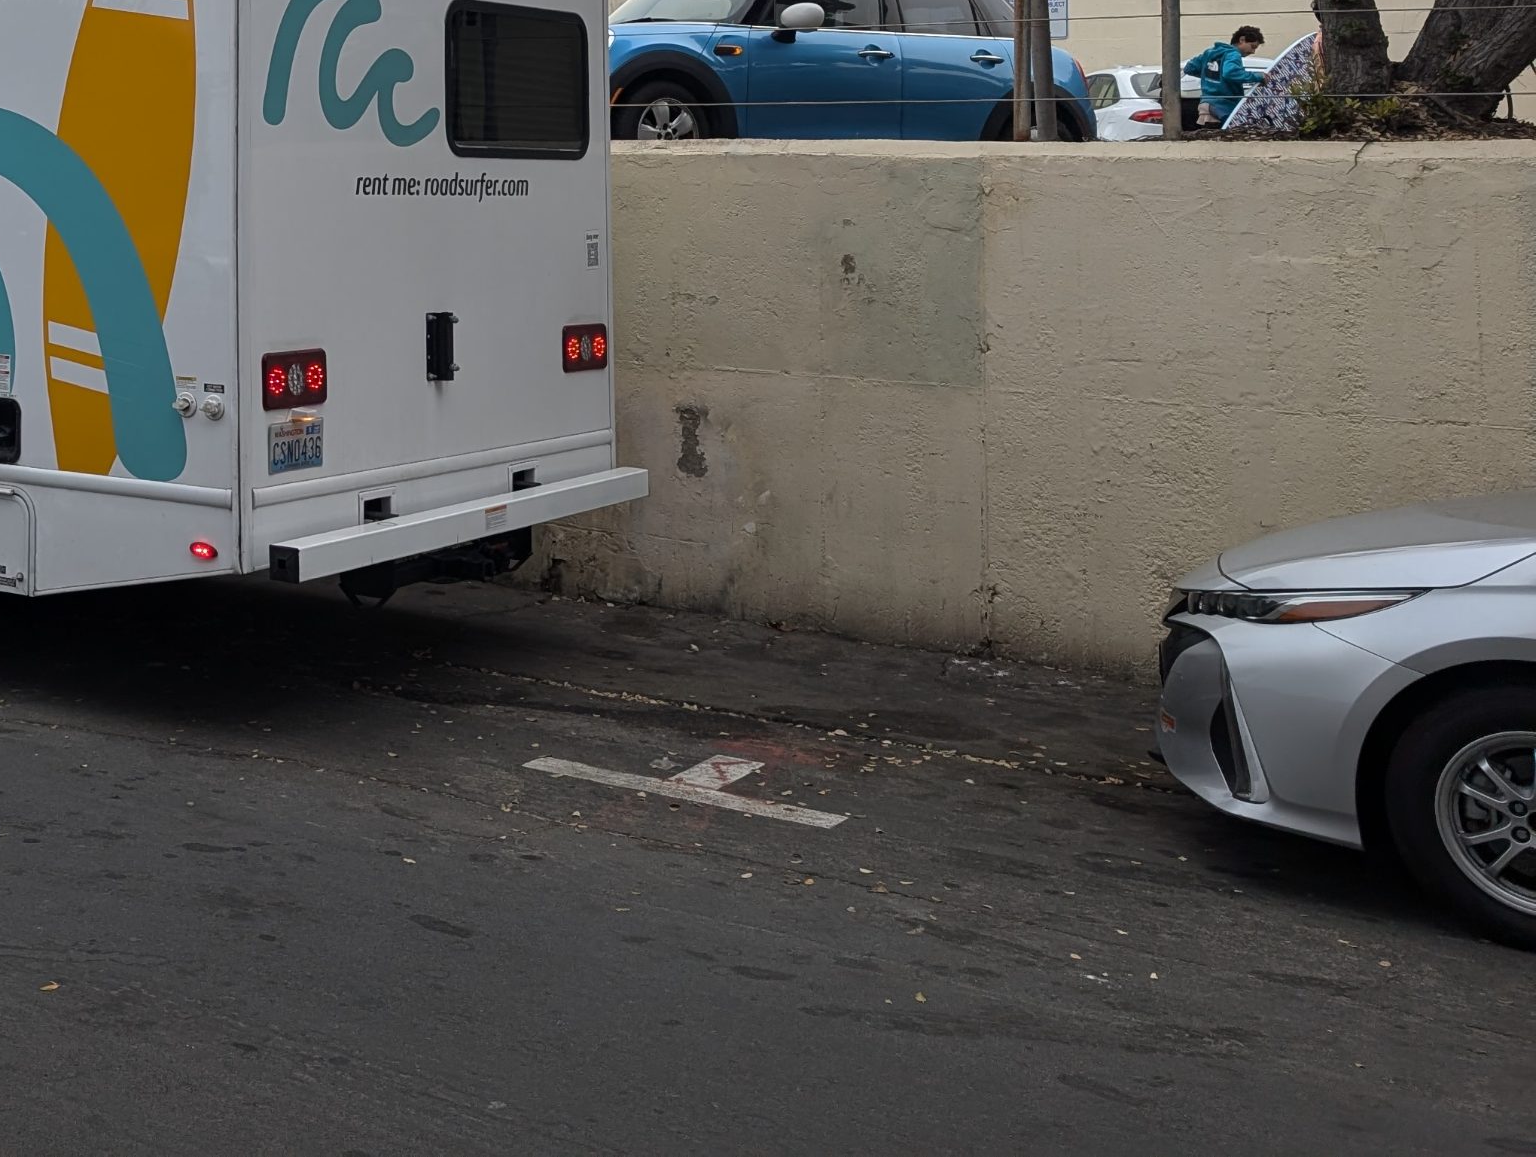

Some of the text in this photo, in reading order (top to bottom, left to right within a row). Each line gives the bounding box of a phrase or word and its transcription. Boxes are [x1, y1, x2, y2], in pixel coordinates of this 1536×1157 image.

[355, 172, 529, 203] rent me: roadsurfer.com
